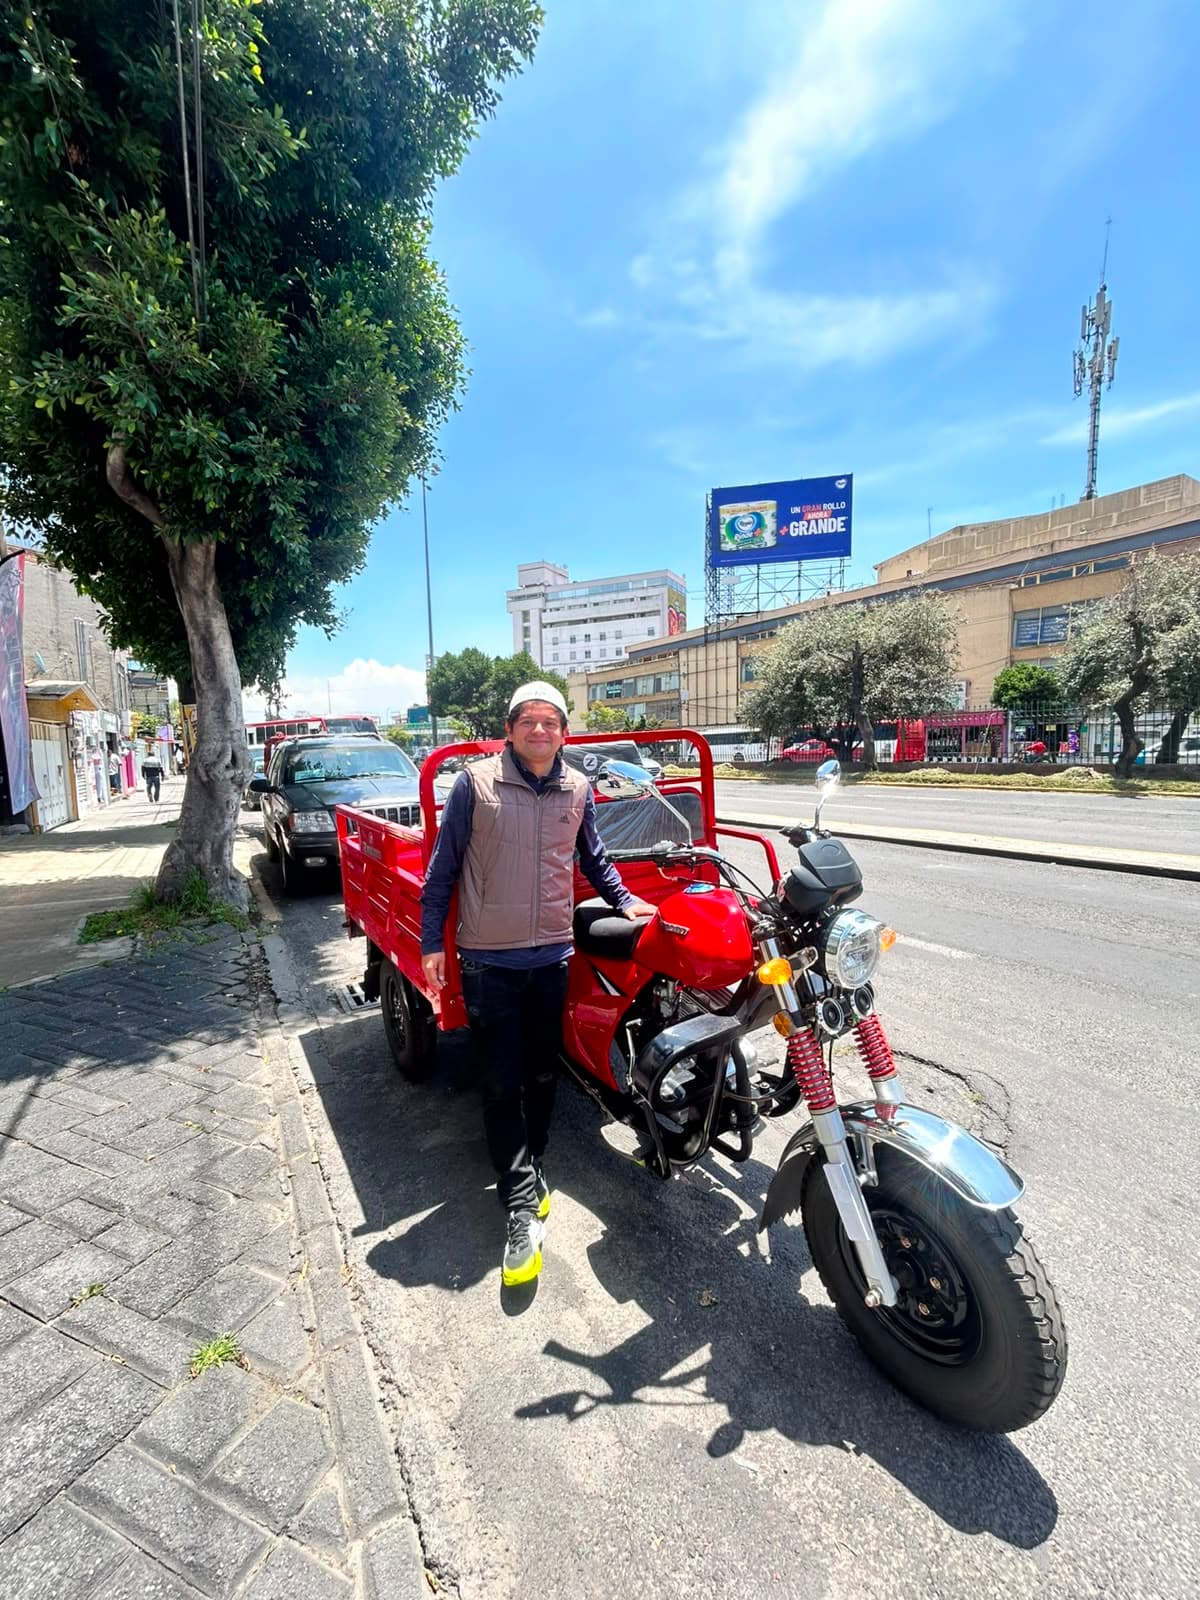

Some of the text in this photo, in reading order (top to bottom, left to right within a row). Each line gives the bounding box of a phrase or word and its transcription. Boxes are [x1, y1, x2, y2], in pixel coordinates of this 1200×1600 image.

[790, 501, 846, 514] UN GRAN ROLLO
[807, 510, 829, 520] AHORA
[789, 516, 846, 537] GRANDE
